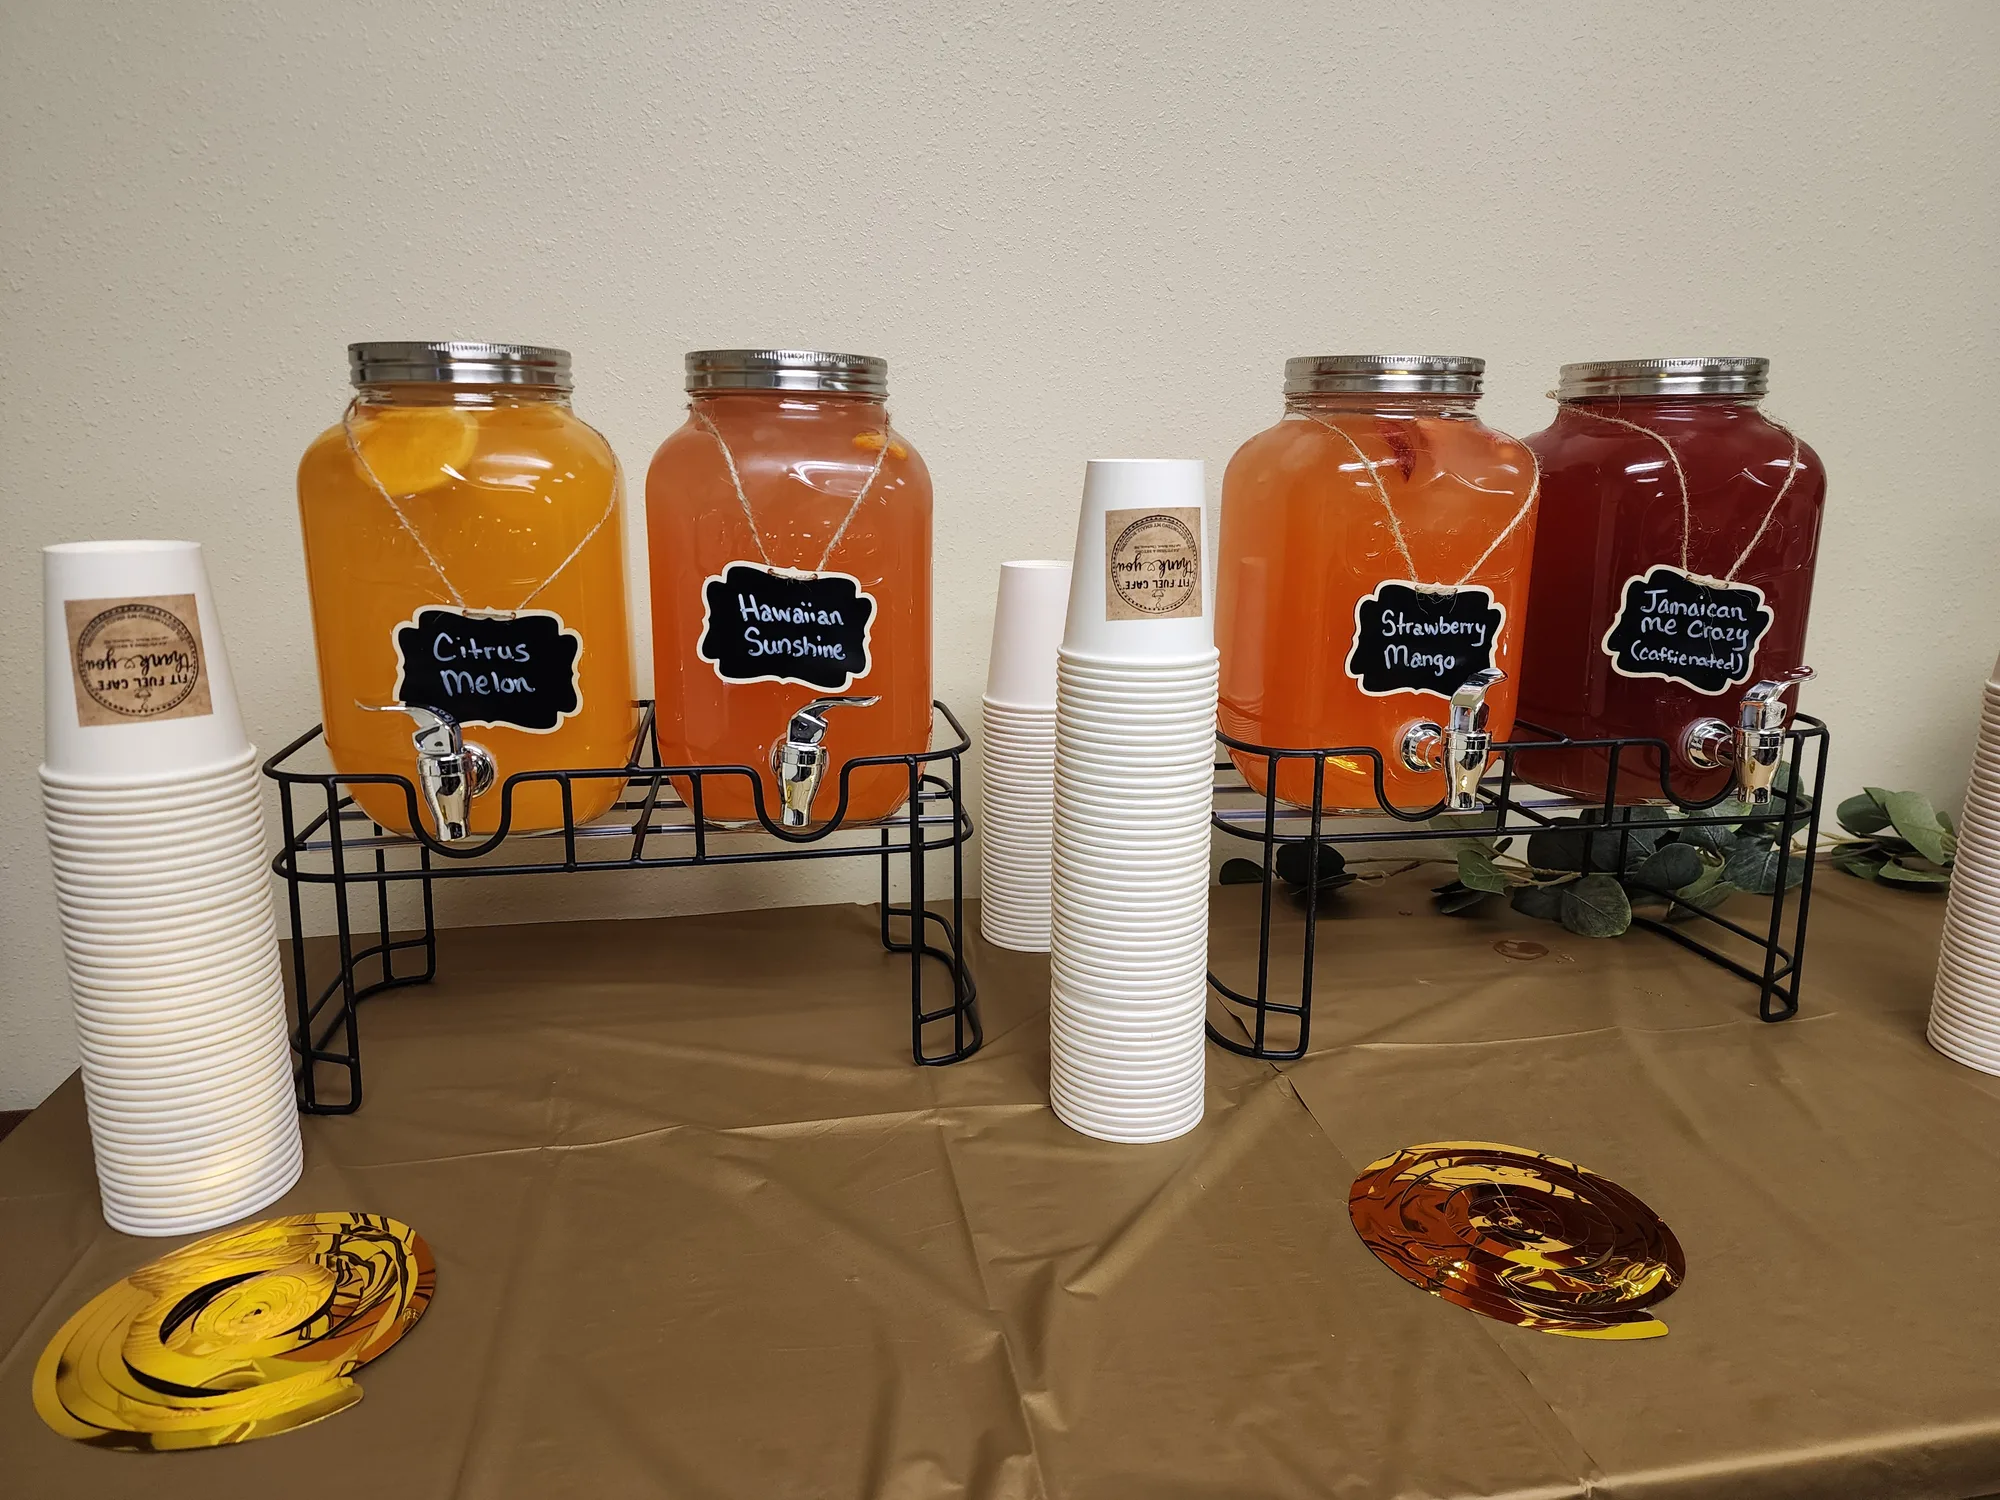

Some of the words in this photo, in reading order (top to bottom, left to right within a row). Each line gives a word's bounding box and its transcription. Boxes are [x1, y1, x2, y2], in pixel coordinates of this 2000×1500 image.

[1115, 552, 1142, 572] you
[1156, 557, 1194, 579] thank
[1125, 580, 1149, 590] CAFE
[1152, 579, 1175, 589] FUEL
[1177, 579, 1190, 588] FIT
[738, 593, 845, 626] Hawaiian
[1640, 589, 1747, 622] Jamaican
[1381, 609, 1487, 647] Strawberry
[1687, 620, 1750, 650] Crazy
[433, 632, 531, 662] Citrus
[744, 626, 847, 661] Sunshine
[83, 647, 117, 671] you
[138, 651, 193, 676] thank
[1384, 644, 1456, 677] Mango
[1630, 640, 1743, 674] (caffienated)
[97, 678, 129, 691] CAFE
[134, 676, 165, 689] FUEL
[170, 674, 188, 685] FIT
[439, 669, 536, 697] Melon
